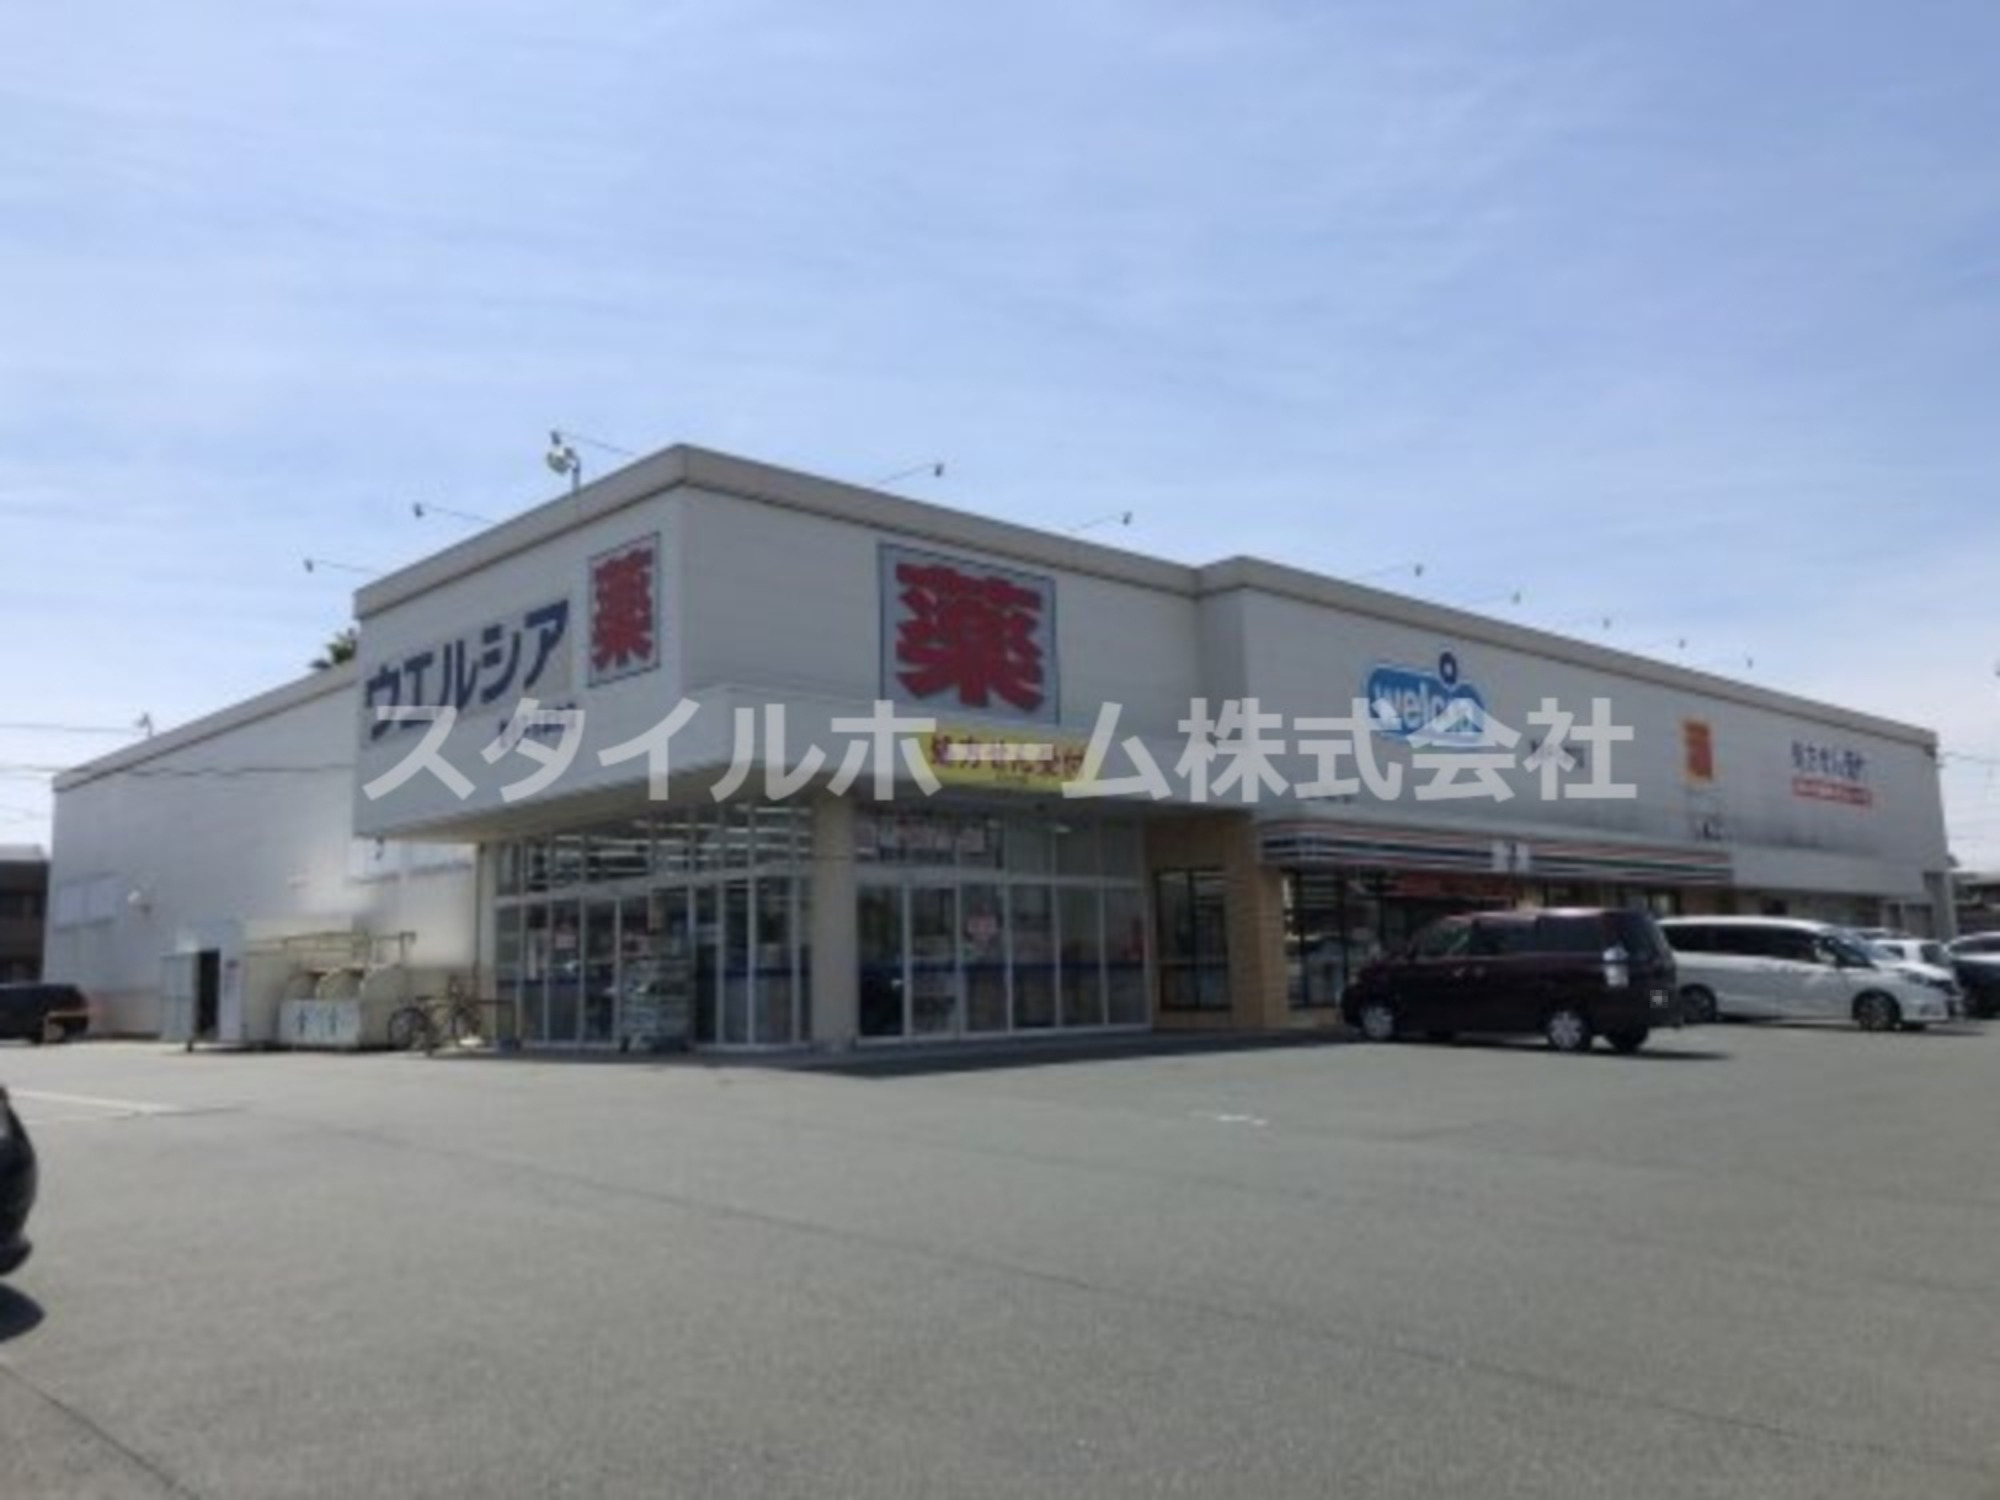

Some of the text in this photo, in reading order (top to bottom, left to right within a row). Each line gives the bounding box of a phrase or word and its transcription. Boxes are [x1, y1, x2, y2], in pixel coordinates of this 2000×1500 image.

[364, 599, 569, 741] ウエルシア
[895, 562, 1046, 714] 薬
